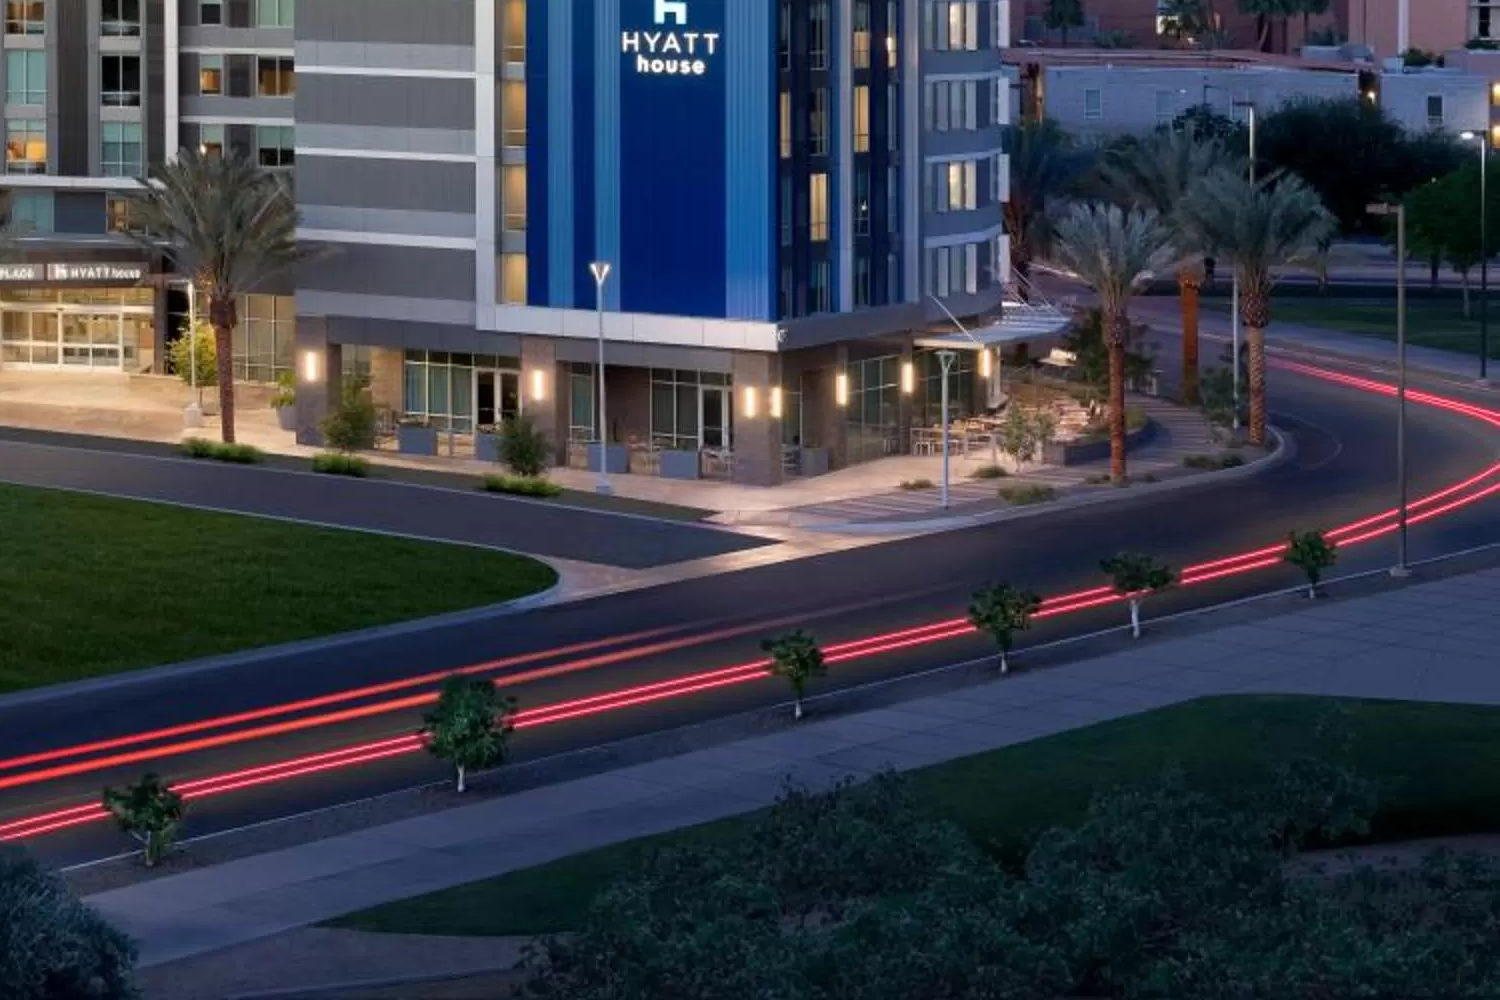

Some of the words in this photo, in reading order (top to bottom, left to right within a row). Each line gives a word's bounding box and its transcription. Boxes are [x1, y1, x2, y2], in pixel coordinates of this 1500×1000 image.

[622, 32, 719, 55] HYATT
[636, 54, 705, 75] house
[71, 267, 110, 280] HYATT
